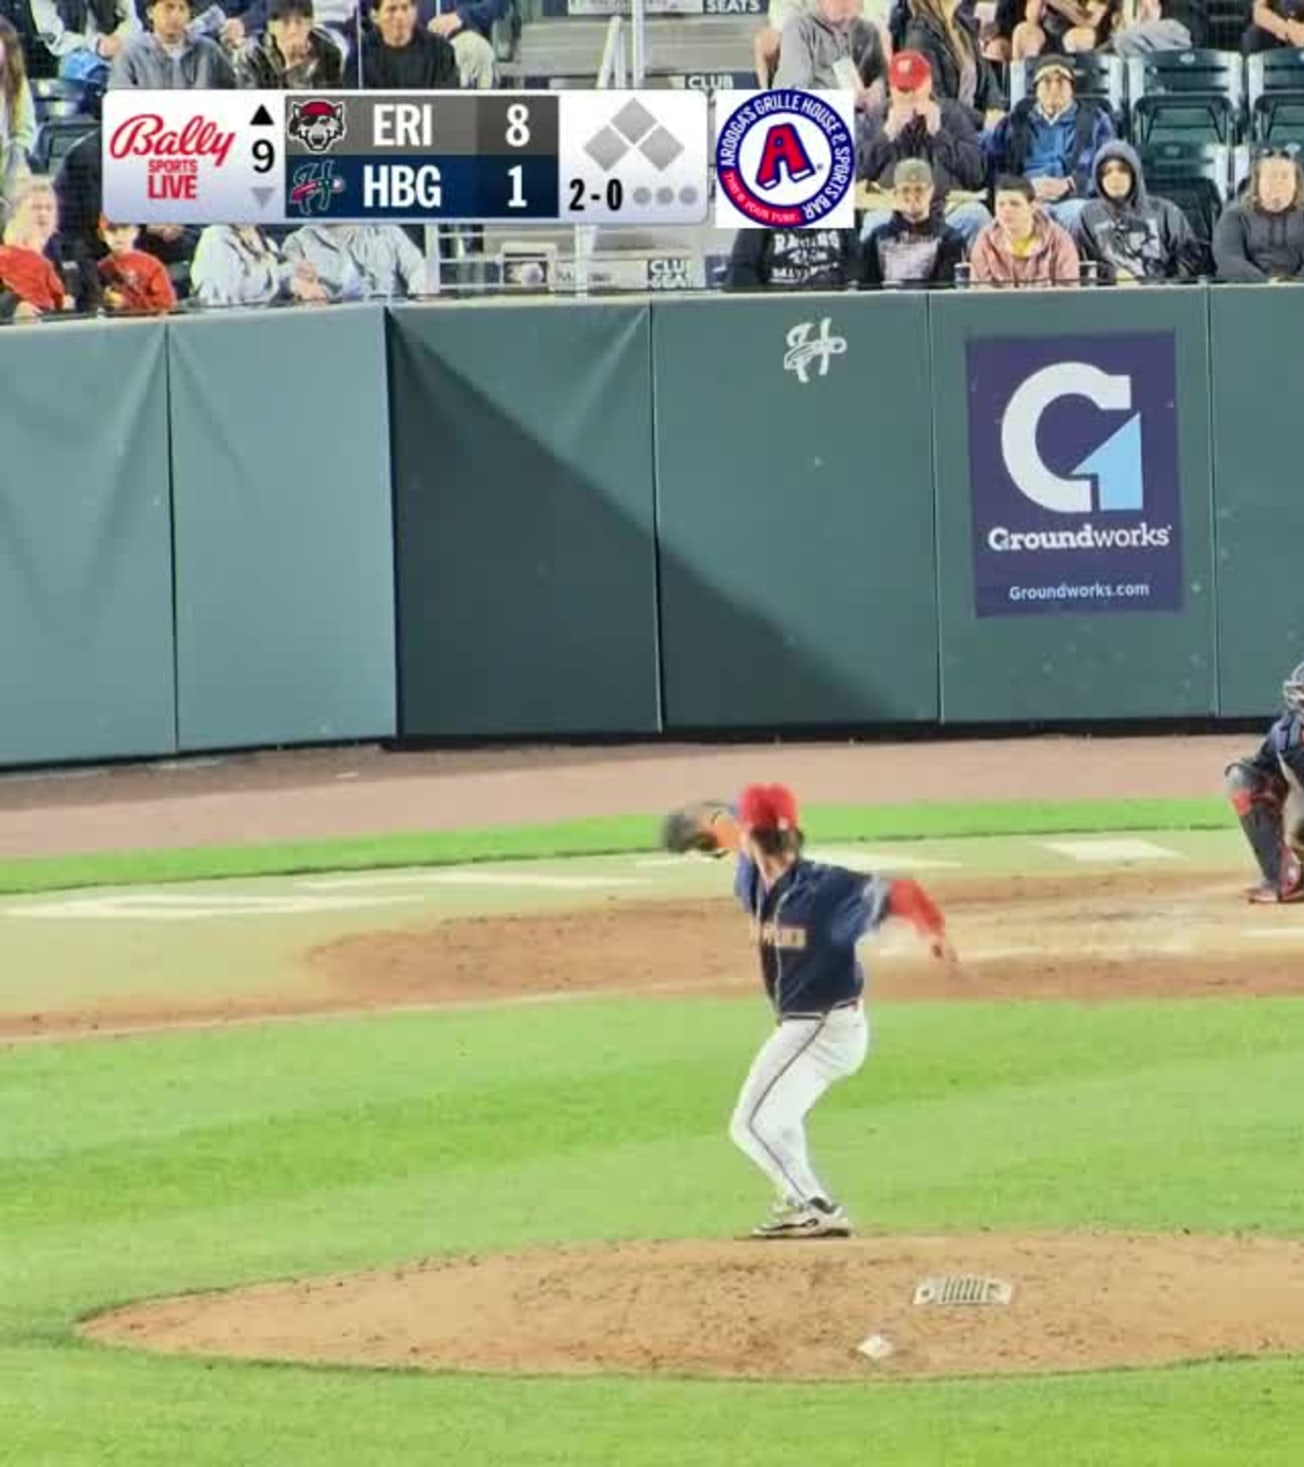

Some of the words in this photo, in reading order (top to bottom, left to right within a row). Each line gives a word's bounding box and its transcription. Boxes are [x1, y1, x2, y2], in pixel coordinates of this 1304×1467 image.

[688, 75, 734, 90] CLUB
[649, 259, 686, 275] CLU
[988, 523, 1170, 551] Groundworks
[1009, 581, 1150, 601] Groundworks.com
